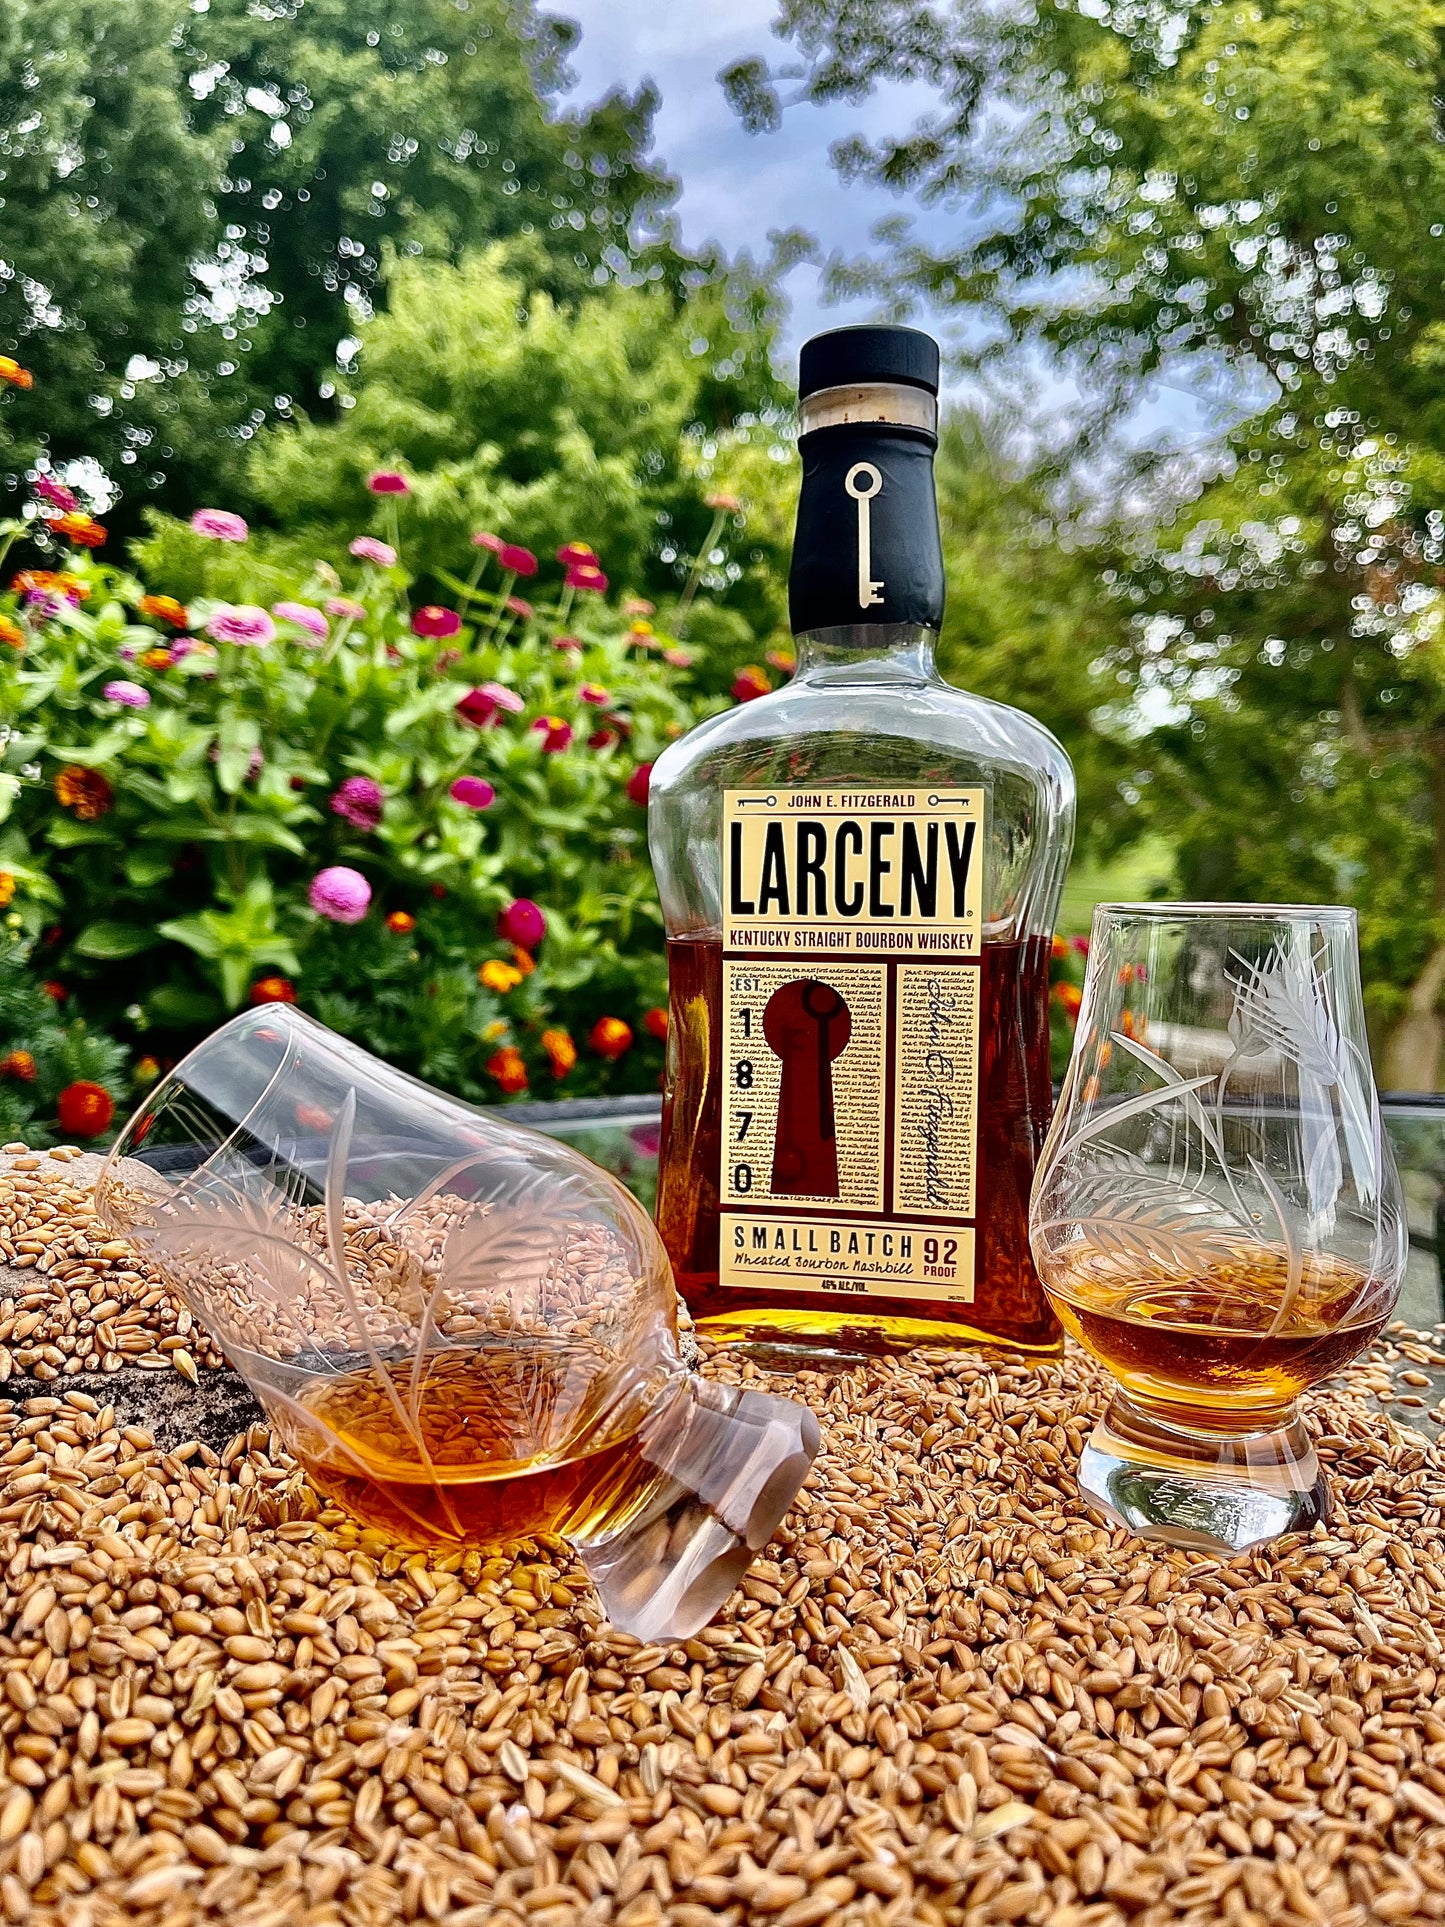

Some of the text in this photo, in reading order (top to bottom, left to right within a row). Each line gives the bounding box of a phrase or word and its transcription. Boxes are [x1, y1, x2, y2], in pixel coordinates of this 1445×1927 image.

[788, 795, 915, 807] JOHN E. FITZGERALD
[730, 821, 976, 918] LARCENY
[730, 930, 973, 950] KENTUCKY STRAIGHT BOURBON WHISKEY
[735, 978, 763, 992] EST.
[927, 979, 957, 1046] John
[918, 1088, 954, 1207] Fitzgerald
[734, 1225, 912, 1258] SMALL BATCH
[923, 1238, 958, 1265] 92
[734, 1253, 791, 1267] Wheated
[796, 1256, 849, 1271] Bourbon
[923, 1265, 958, 1278] PROOF
